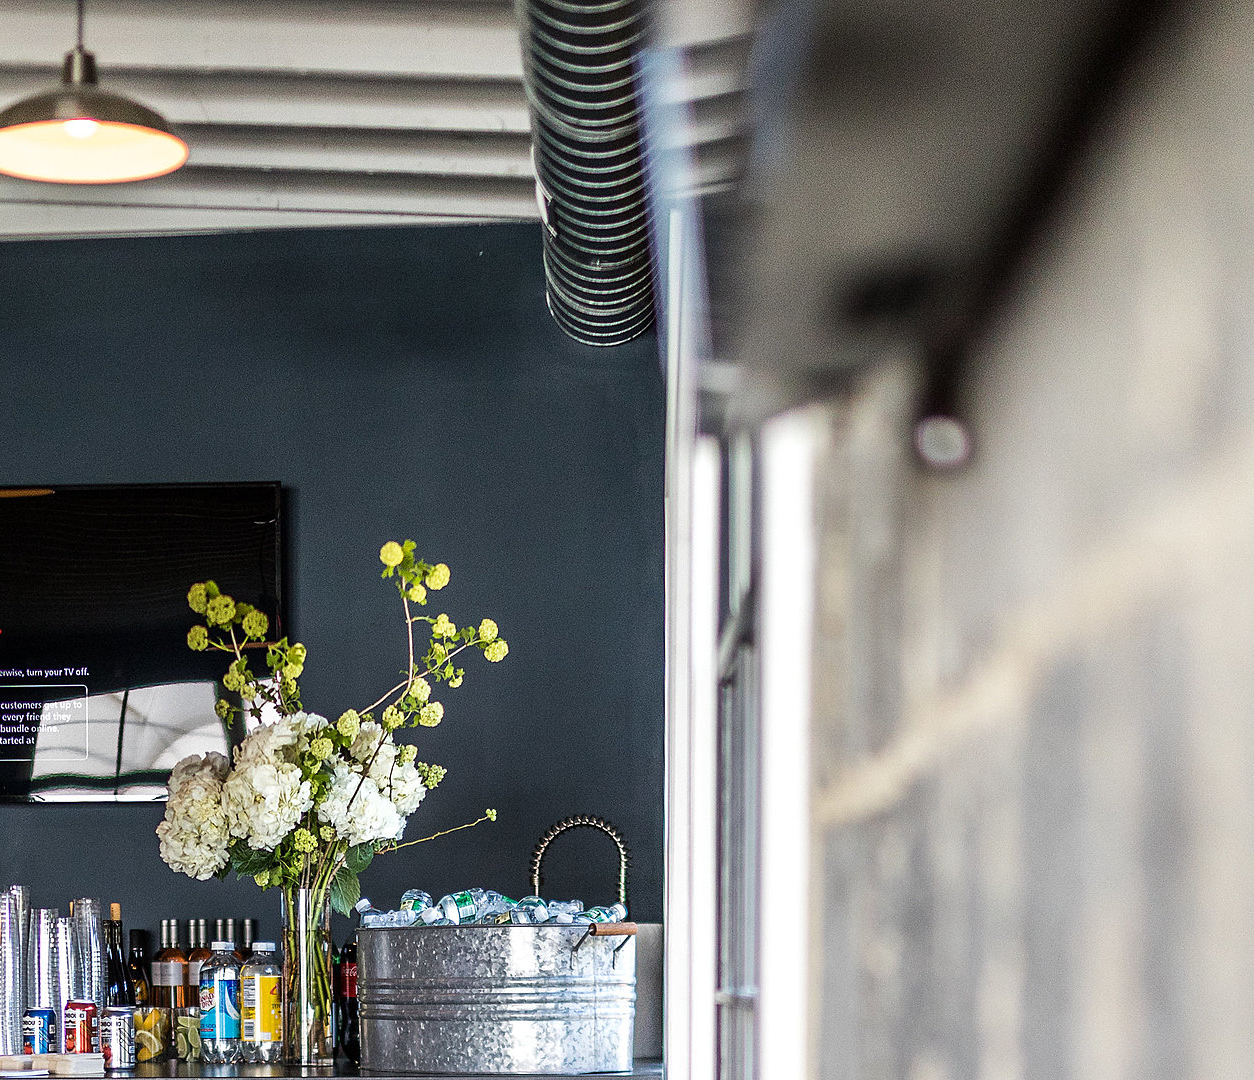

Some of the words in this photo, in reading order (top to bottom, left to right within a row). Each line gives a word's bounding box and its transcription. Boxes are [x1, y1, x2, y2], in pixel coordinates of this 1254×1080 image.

[26, 668, 43, 677] turn
[44, 668, 63, 678] your
[64, 667, 74, 676] TV
[75, 667, 90, 676] off.
[0, 701, 42, 710] customers
[2, 713, 25, 723] every
[25, 712, 51, 721] friend
[0, 723, 30, 733] bundle
[25, 736, 35, 745] at
